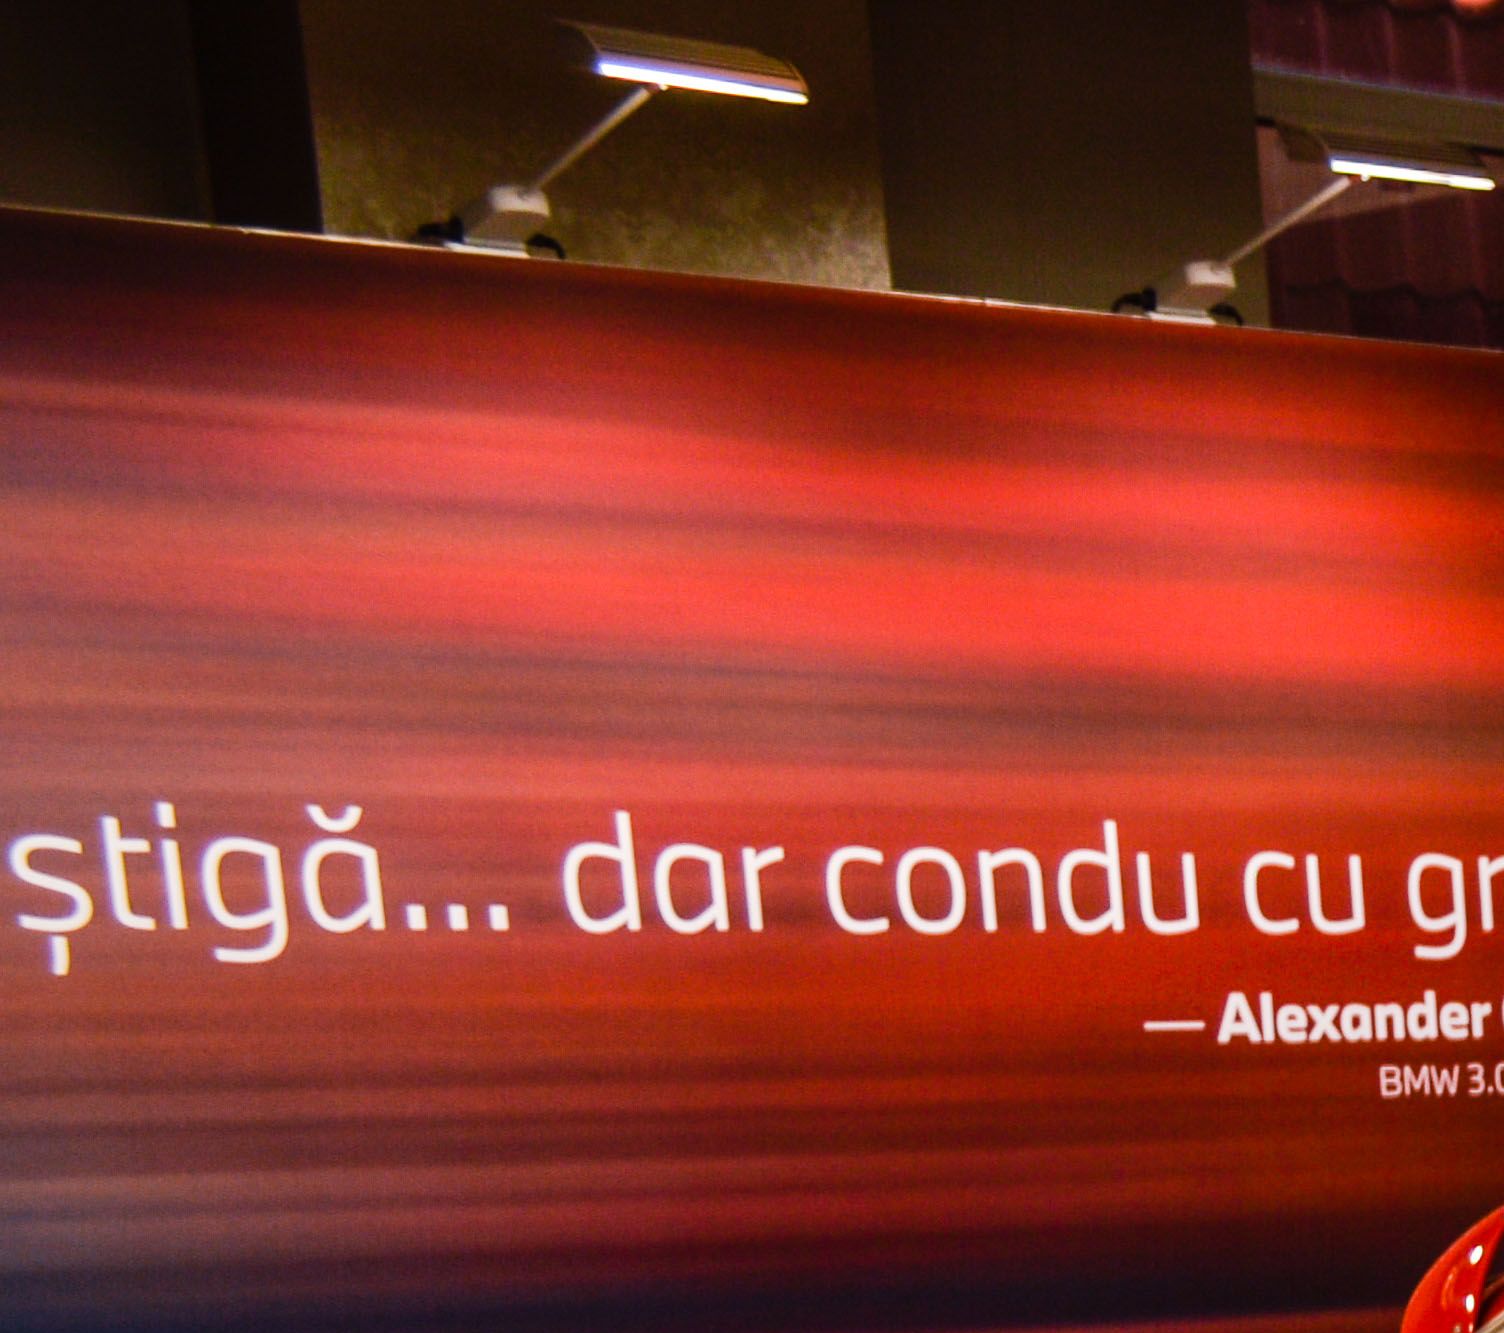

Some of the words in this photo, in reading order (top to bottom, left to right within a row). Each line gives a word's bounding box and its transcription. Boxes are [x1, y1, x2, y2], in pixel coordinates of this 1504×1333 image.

[562, 811, 785, 934] dar
[825, 819, 1200, 935] condu
[1242, 851, 1367, 934] cu
[1217, 990, 1491, 1045] Alexander
[1378, 1065, 1460, 1099] BMW
